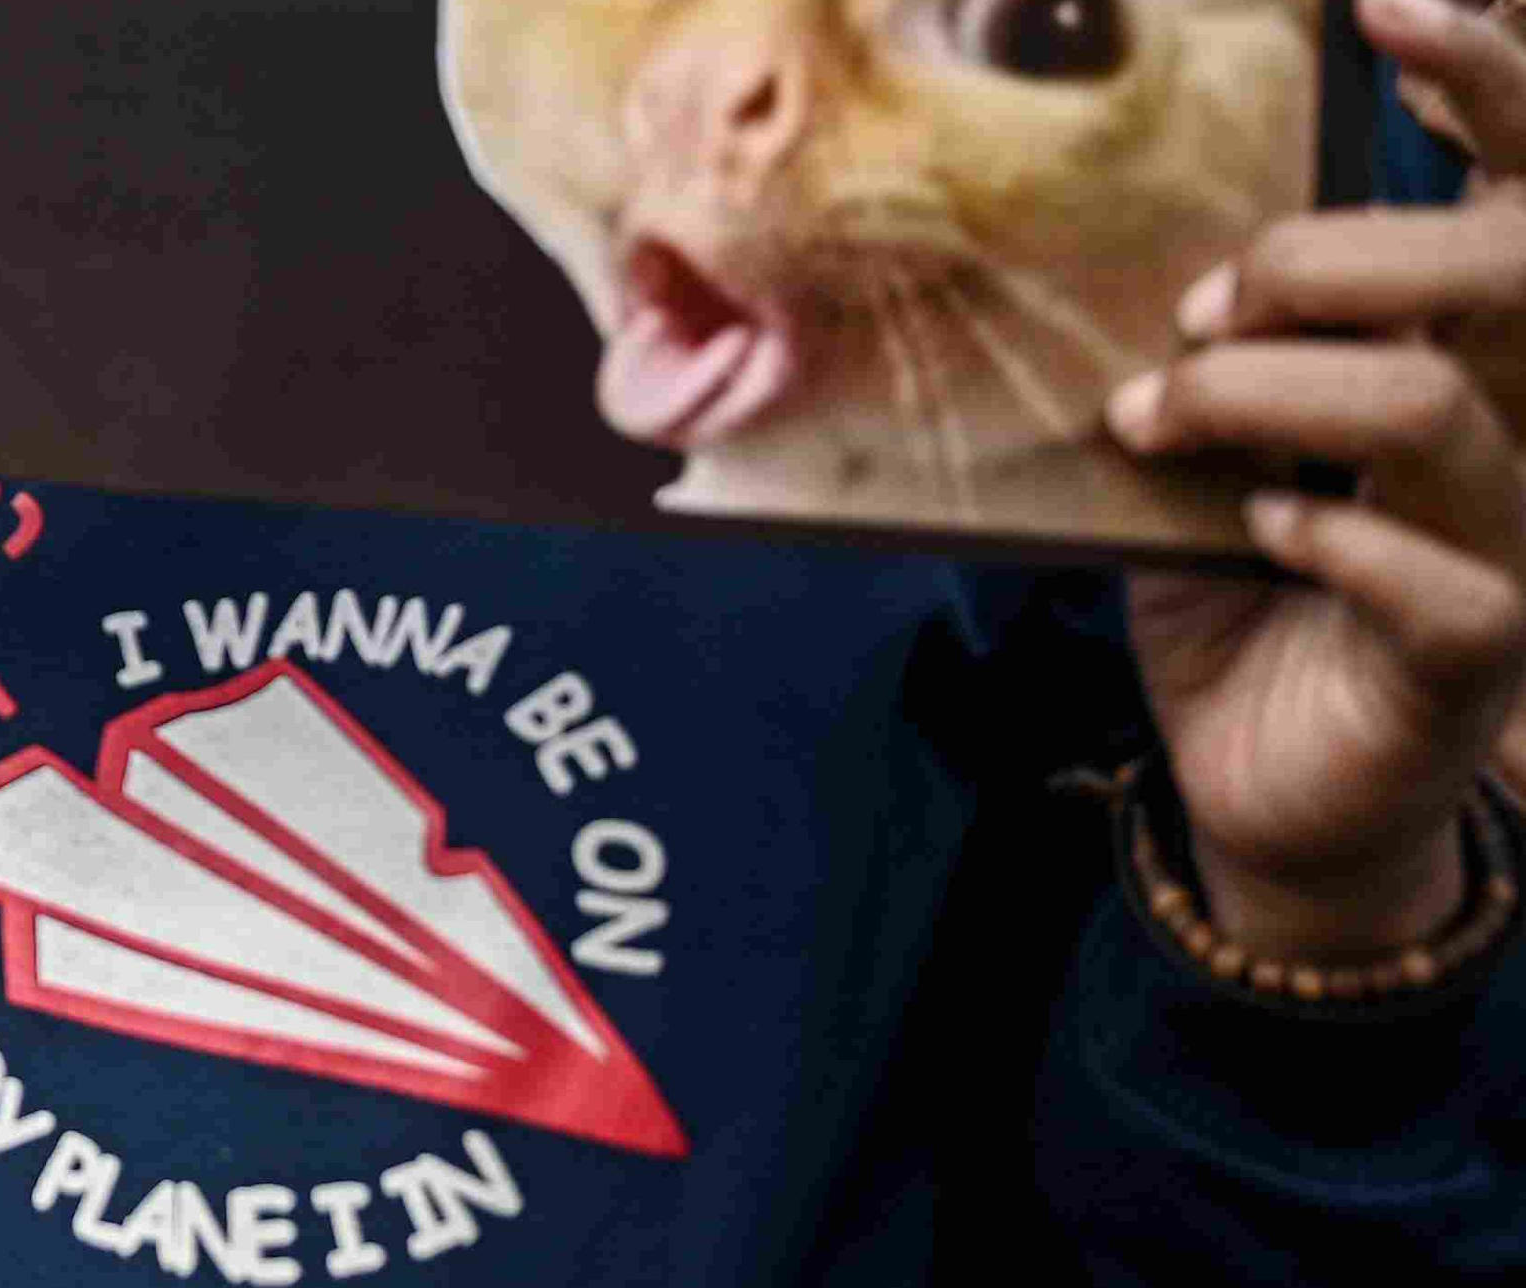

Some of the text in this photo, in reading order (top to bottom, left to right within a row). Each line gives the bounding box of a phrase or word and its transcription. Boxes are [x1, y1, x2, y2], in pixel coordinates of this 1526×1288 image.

[102, 589, 669, 975] I WANNA BE ON
[31, 1129, 303, 1286] PLANE
[309, 1180, 388, 1279] I
